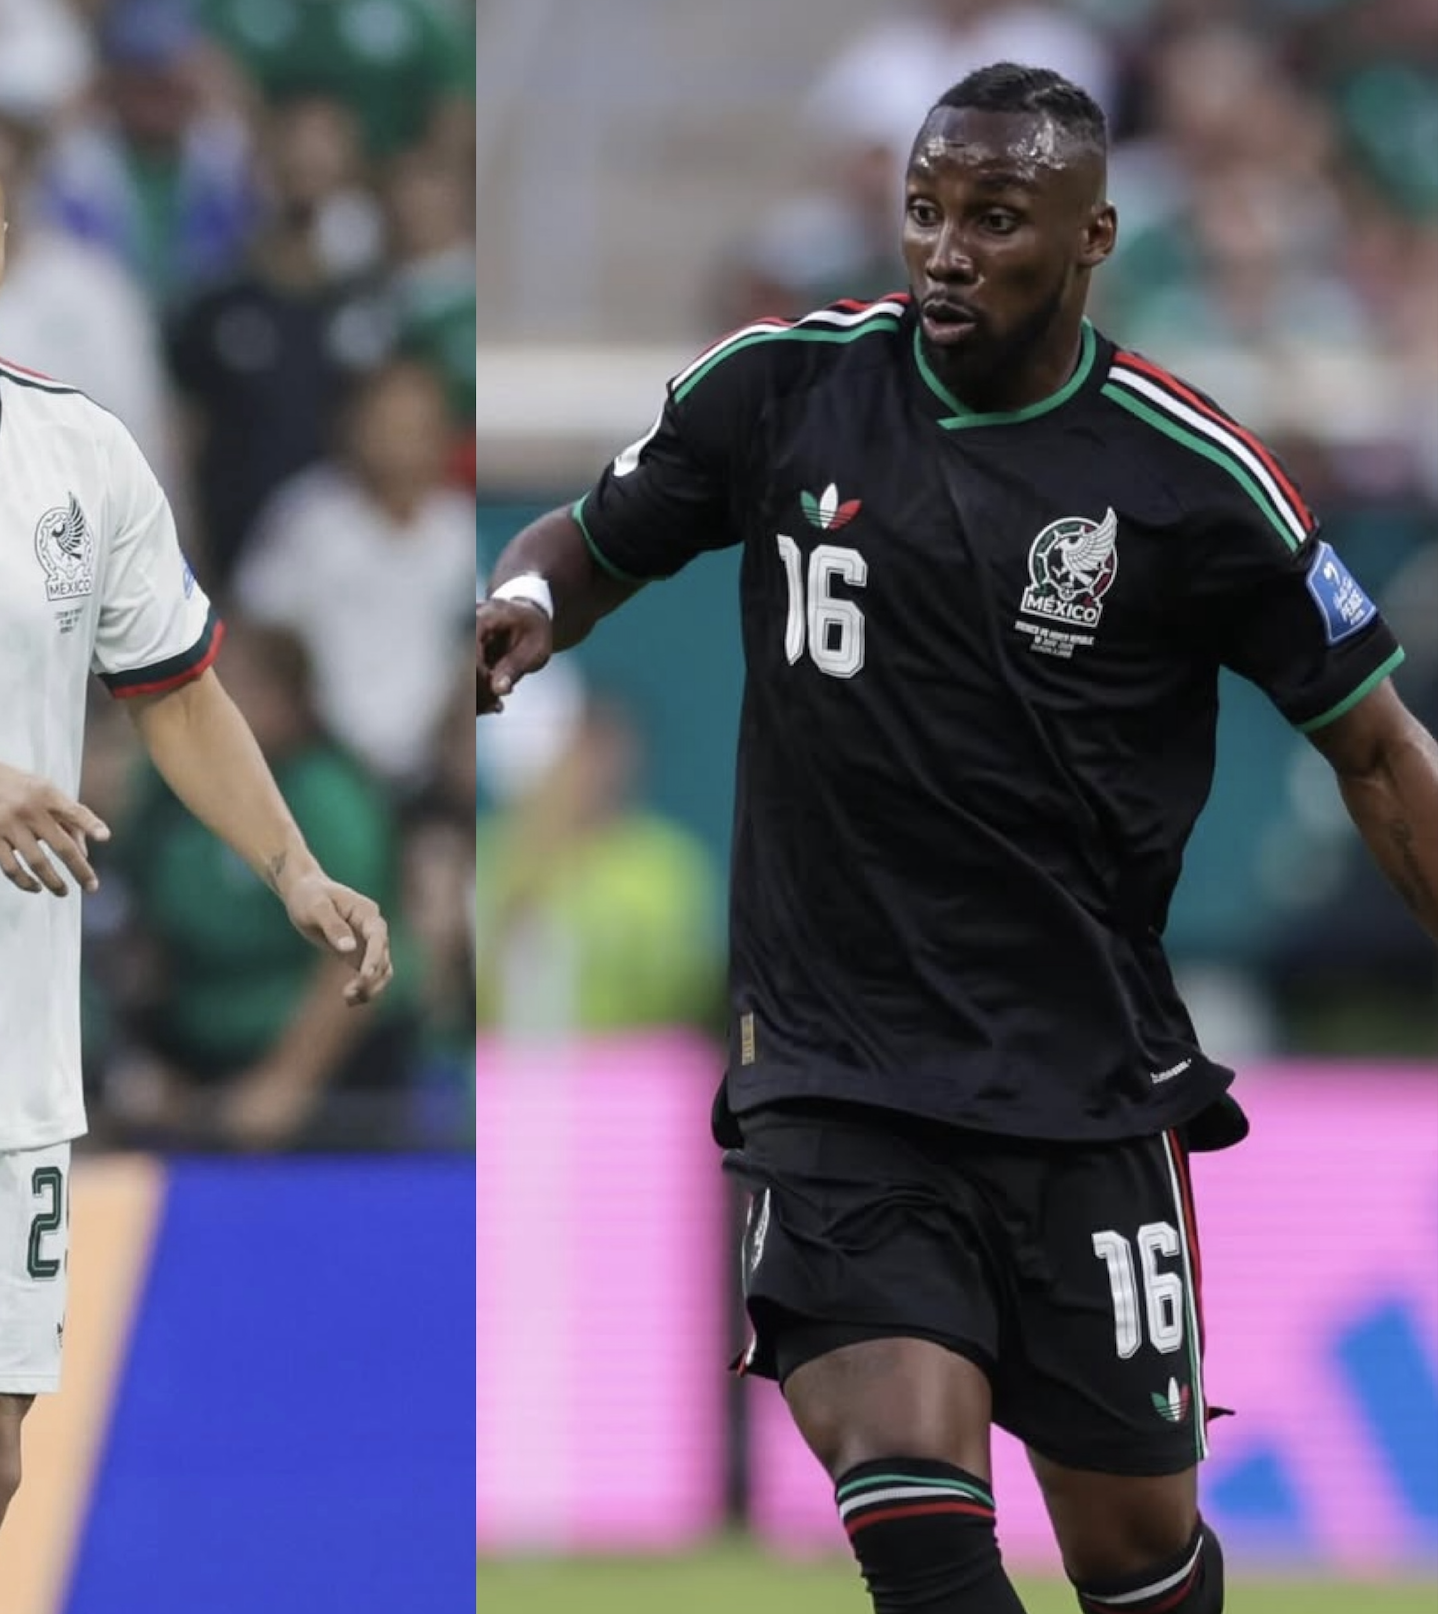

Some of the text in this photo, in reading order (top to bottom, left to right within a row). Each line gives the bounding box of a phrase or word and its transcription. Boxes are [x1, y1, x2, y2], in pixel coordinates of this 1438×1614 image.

[776, 533, 868, 679] 16
[27, 1166, 69, 1280] 2
[1091, 1221, 1183, 1359] 16
